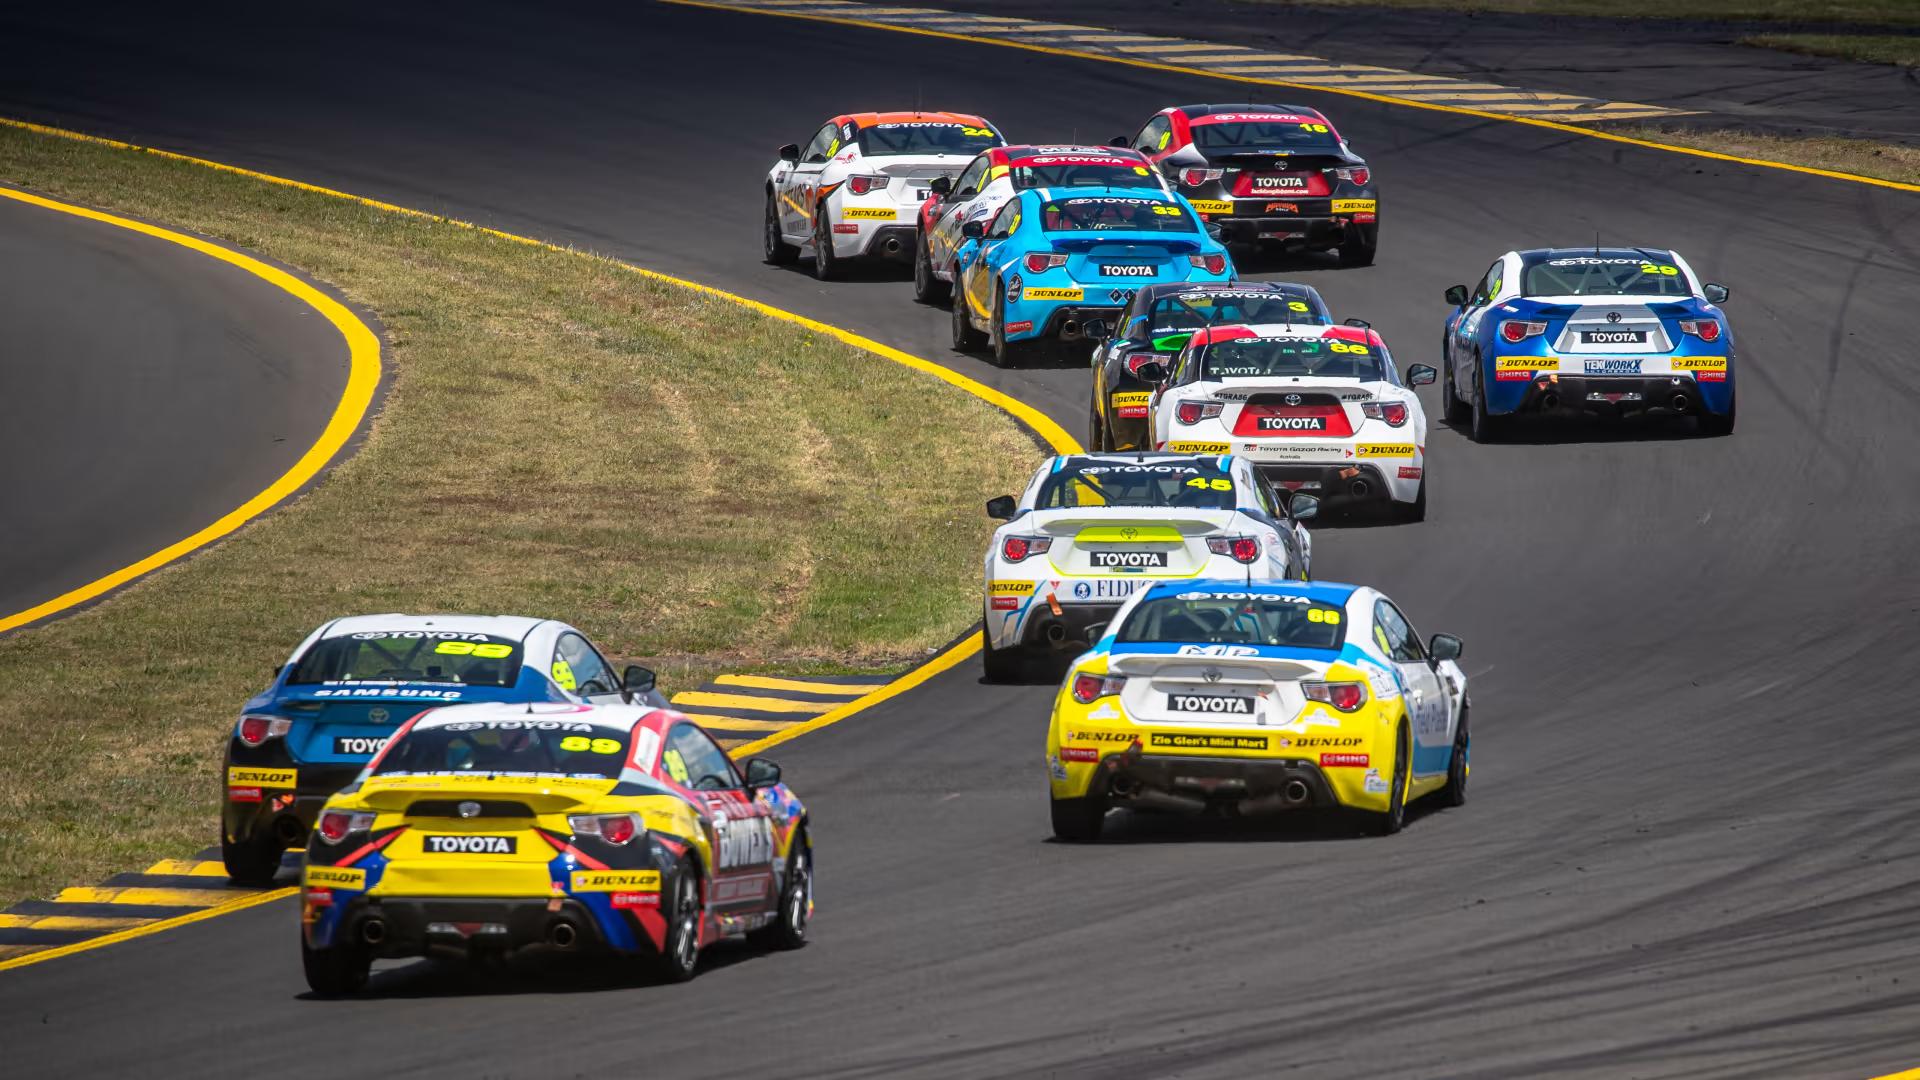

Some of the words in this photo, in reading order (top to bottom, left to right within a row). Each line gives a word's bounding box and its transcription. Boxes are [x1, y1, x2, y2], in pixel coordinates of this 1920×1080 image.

[961, 127, 995, 137] 24
[1256, 178, 1303, 187] TOYOTA
[1152, 206, 1182, 216] 33
[1103, 265, 1154, 275] TOYOTA
[1641, 264, 1678, 275] 29
[1033, 290, 1082, 298] DUNLOP
[1209, 292, 1282, 300] TOYOTA
[1261, 336, 1341, 344] TOYOTA
[1589, 332, 1638, 342] TOYOTA
[1505, 359, 1558, 367] DUNLOP
[1683, 359, 1725, 367] DUNLOP
[1263, 418, 1321, 429] TOYOTA
[1178, 444, 1229, 452] DUNLOP
[1370, 446, 1414, 454] DUNLOP
[1111, 465, 1199, 474] TOYOTA
[1186, 477, 1233, 491] 45
[1096, 553, 1161, 566] TOYOTA
[990, 582, 1033, 593] DUNLOP
[1213, 592, 1312, 604] TOYOTA
[386, 631, 490, 642] TOYOTA
[434, 641, 513, 658] 99
[314, 688, 462, 698] SAMSUNG
[1174, 696, 1248, 713] TOYOTA
[486, 720, 593, 732] TOYOTA
[1076, 731, 1140, 743] DUNLOP
[1210, 737, 1235, 747] Mini
[1237, 738, 1265, 748] Mart
[1295, 737, 1363, 748] DUNLOP
[560, 736, 622, 754] 89
[237, 772, 293, 783] DUNLOP
[429, 836, 511, 853] TOYOTA
[591, 875, 658, 886] DUNLOP
